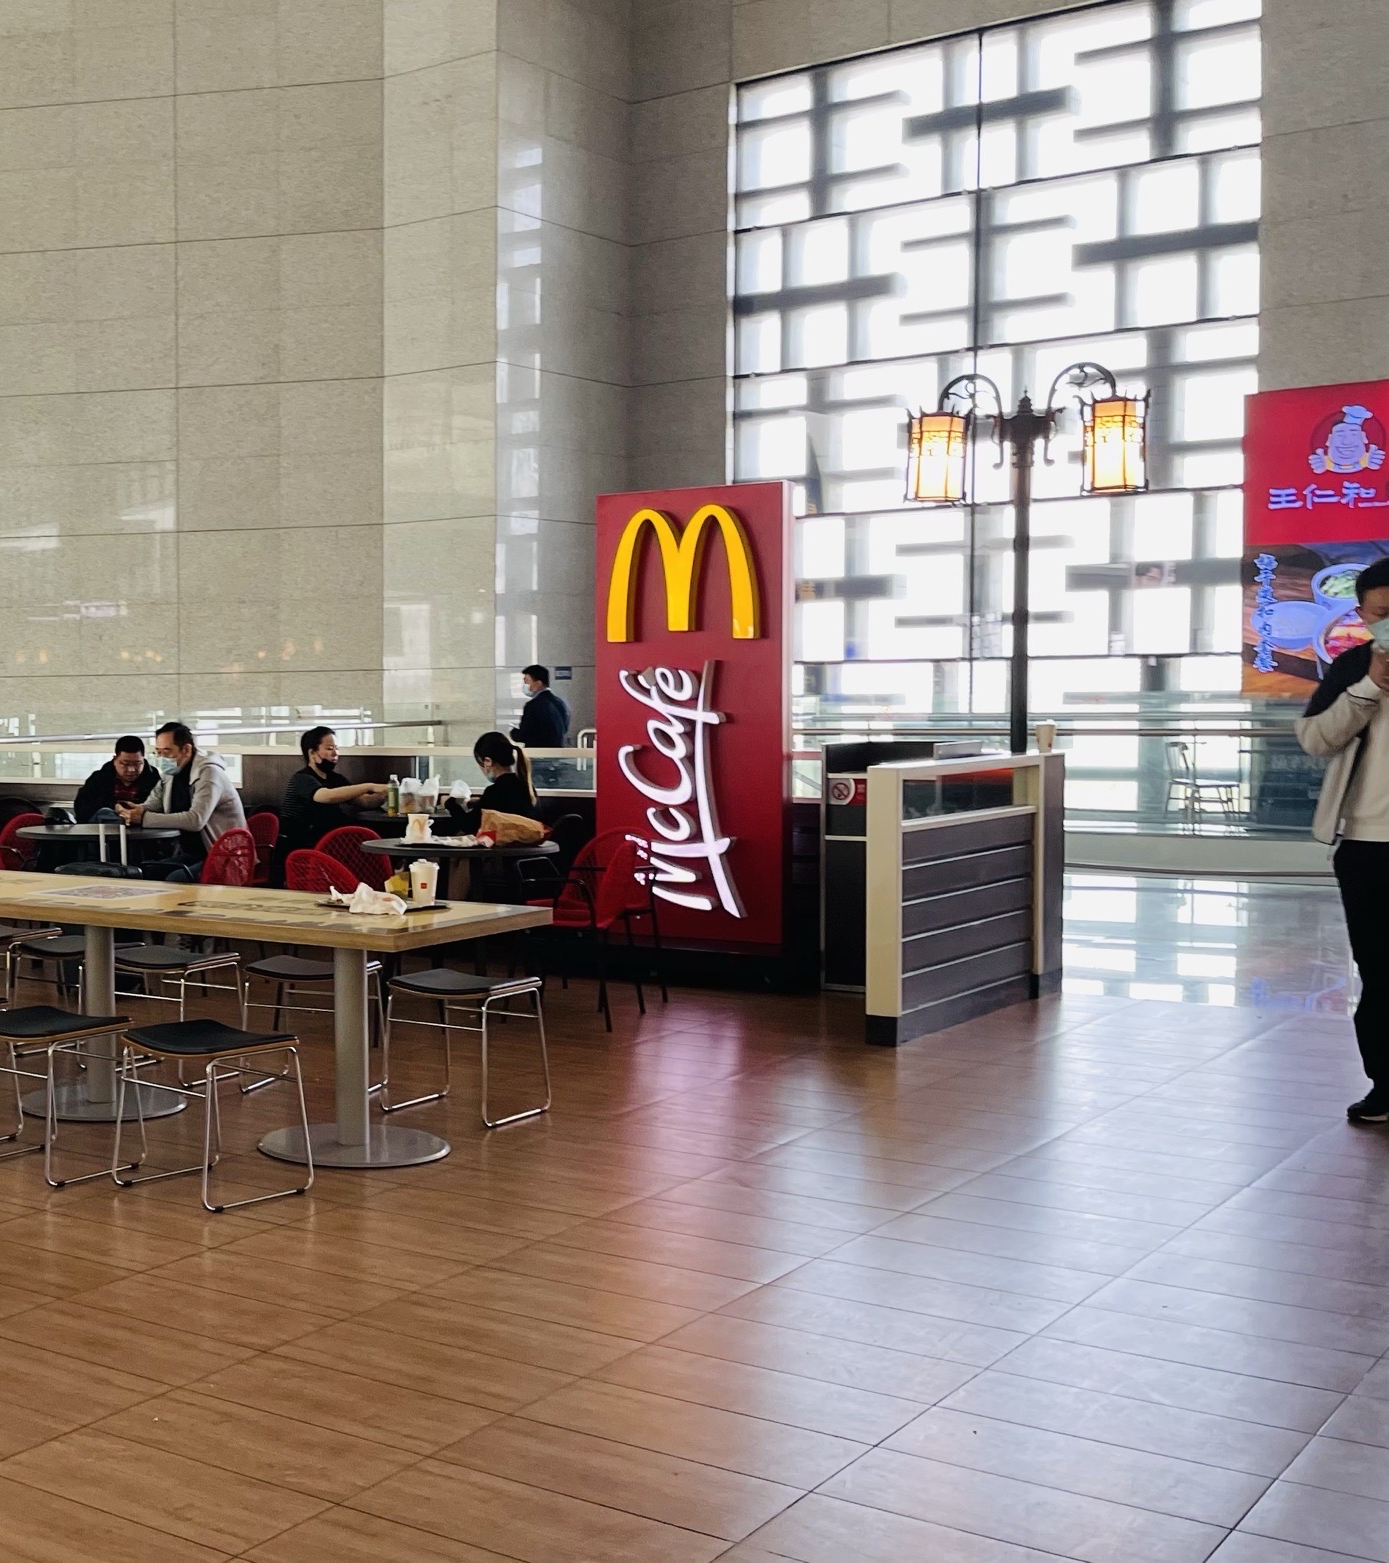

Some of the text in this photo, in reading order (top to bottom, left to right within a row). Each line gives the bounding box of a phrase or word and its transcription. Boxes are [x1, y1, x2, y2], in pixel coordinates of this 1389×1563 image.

[1267, 480, 1383, 510] 王仁和
[618, 660, 748, 918] McCafé
